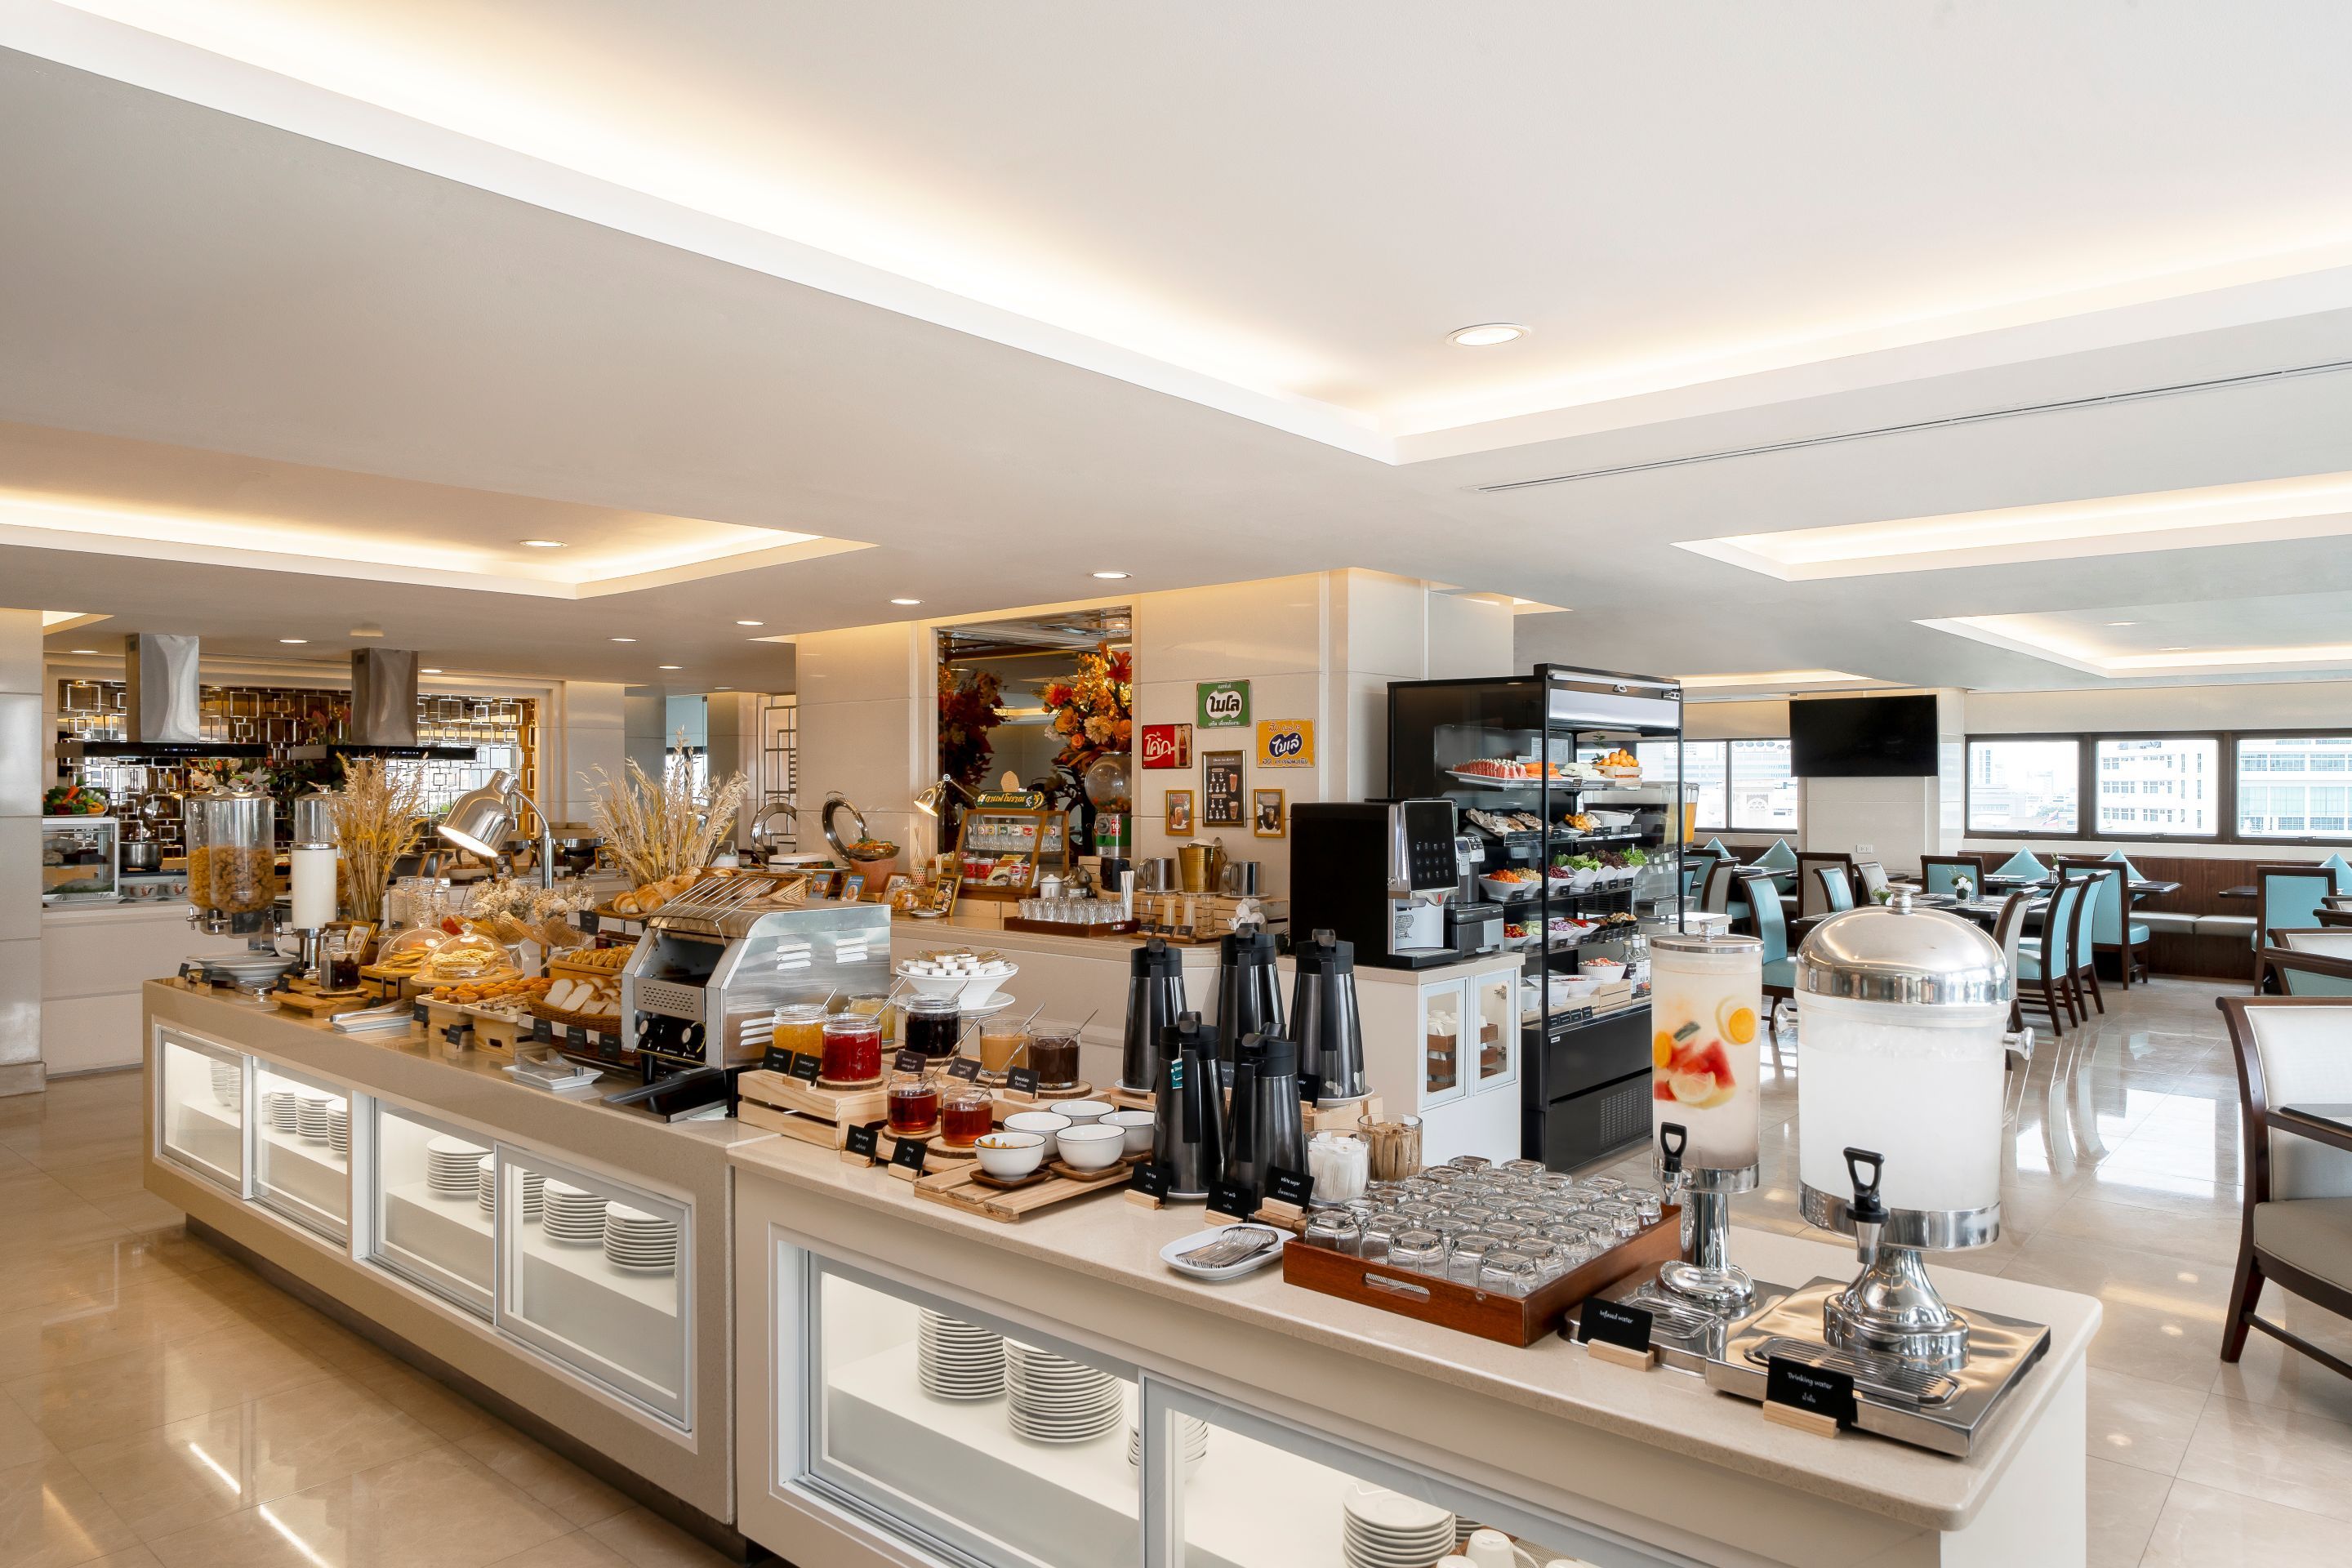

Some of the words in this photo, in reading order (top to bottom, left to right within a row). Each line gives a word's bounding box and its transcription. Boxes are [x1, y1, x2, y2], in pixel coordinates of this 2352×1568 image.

[1209, 694, 1240, 712] ไมโล
[1272, 734, 1299, 755] ไบเล่
[1599, 1309, 1618, 1321] Infused
[1618, 1316, 1633, 1324] water
[1787, 1372, 1814, 1387] Drinking
[1814, 1380, 1833, 1390] water
